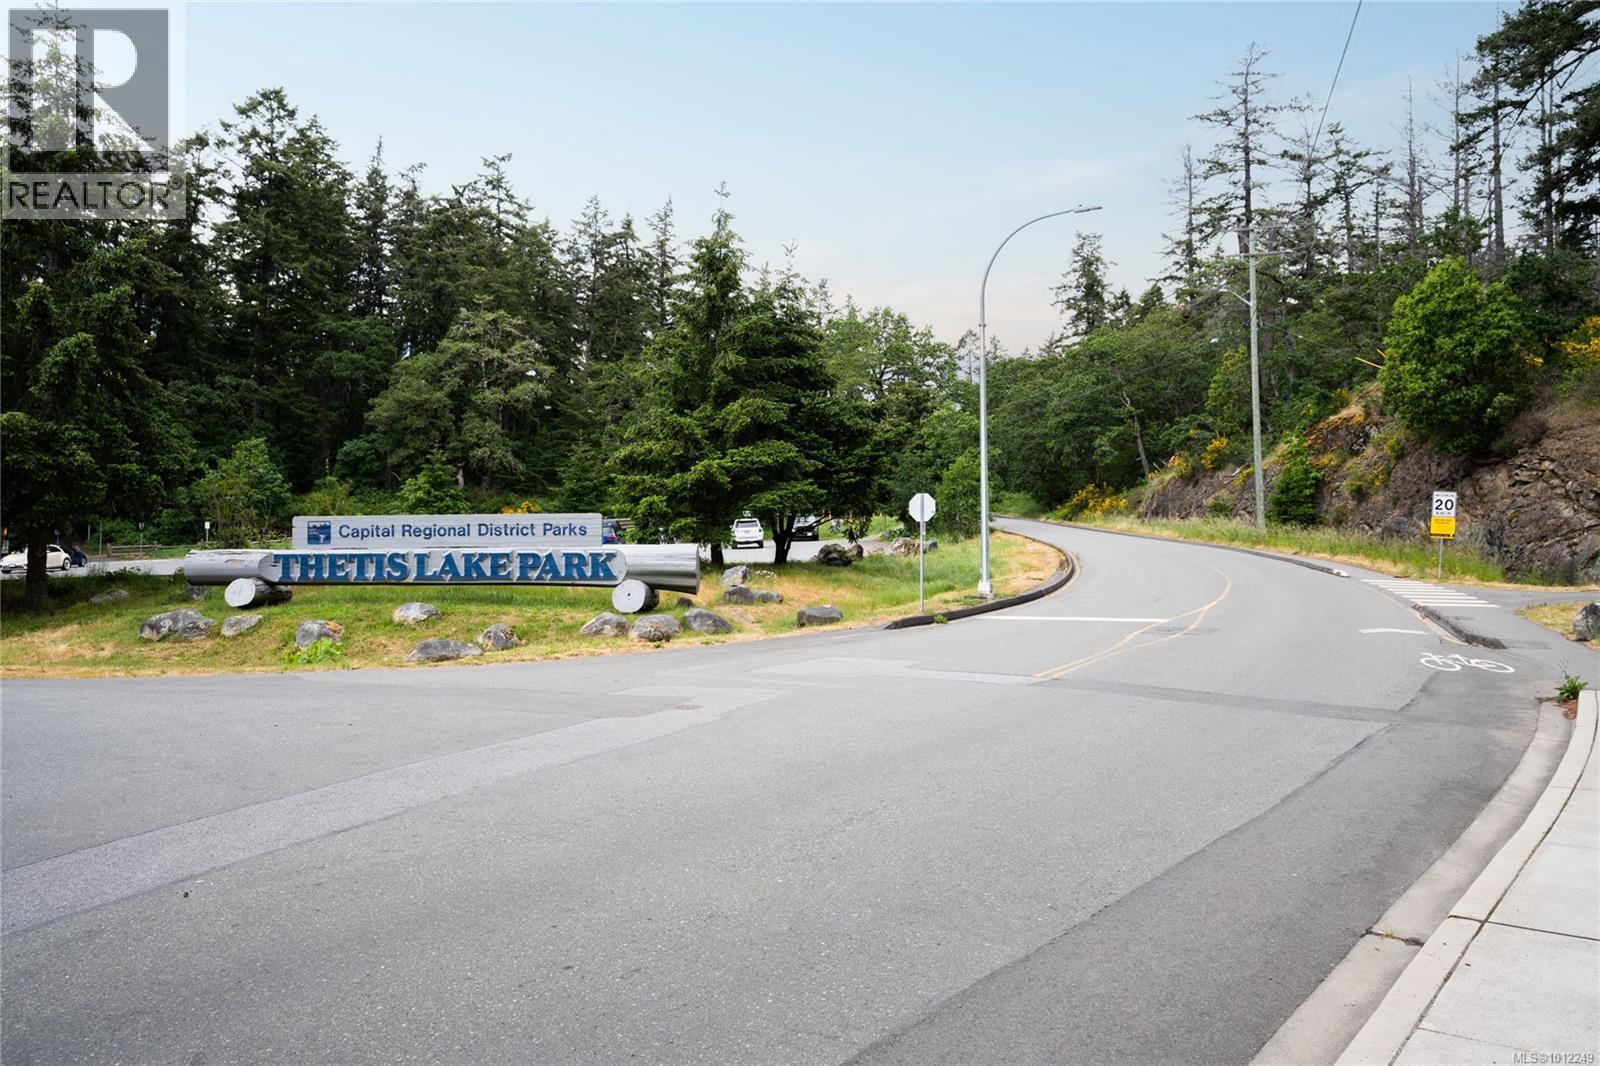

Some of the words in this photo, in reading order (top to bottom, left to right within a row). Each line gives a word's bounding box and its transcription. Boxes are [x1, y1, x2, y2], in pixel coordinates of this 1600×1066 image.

[1435, 498, 1454, 511] 20
[338, 524, 395, 540] Capital
[401, 523, 470, 540] Regional
[478, 523, 536, 537] District
[543, 522, 588, 536] Parks
[272, 551, 410, 582] THETIS
[413, 550, 513, 582] LAKE
[515, 550, 618, 582] PARK
